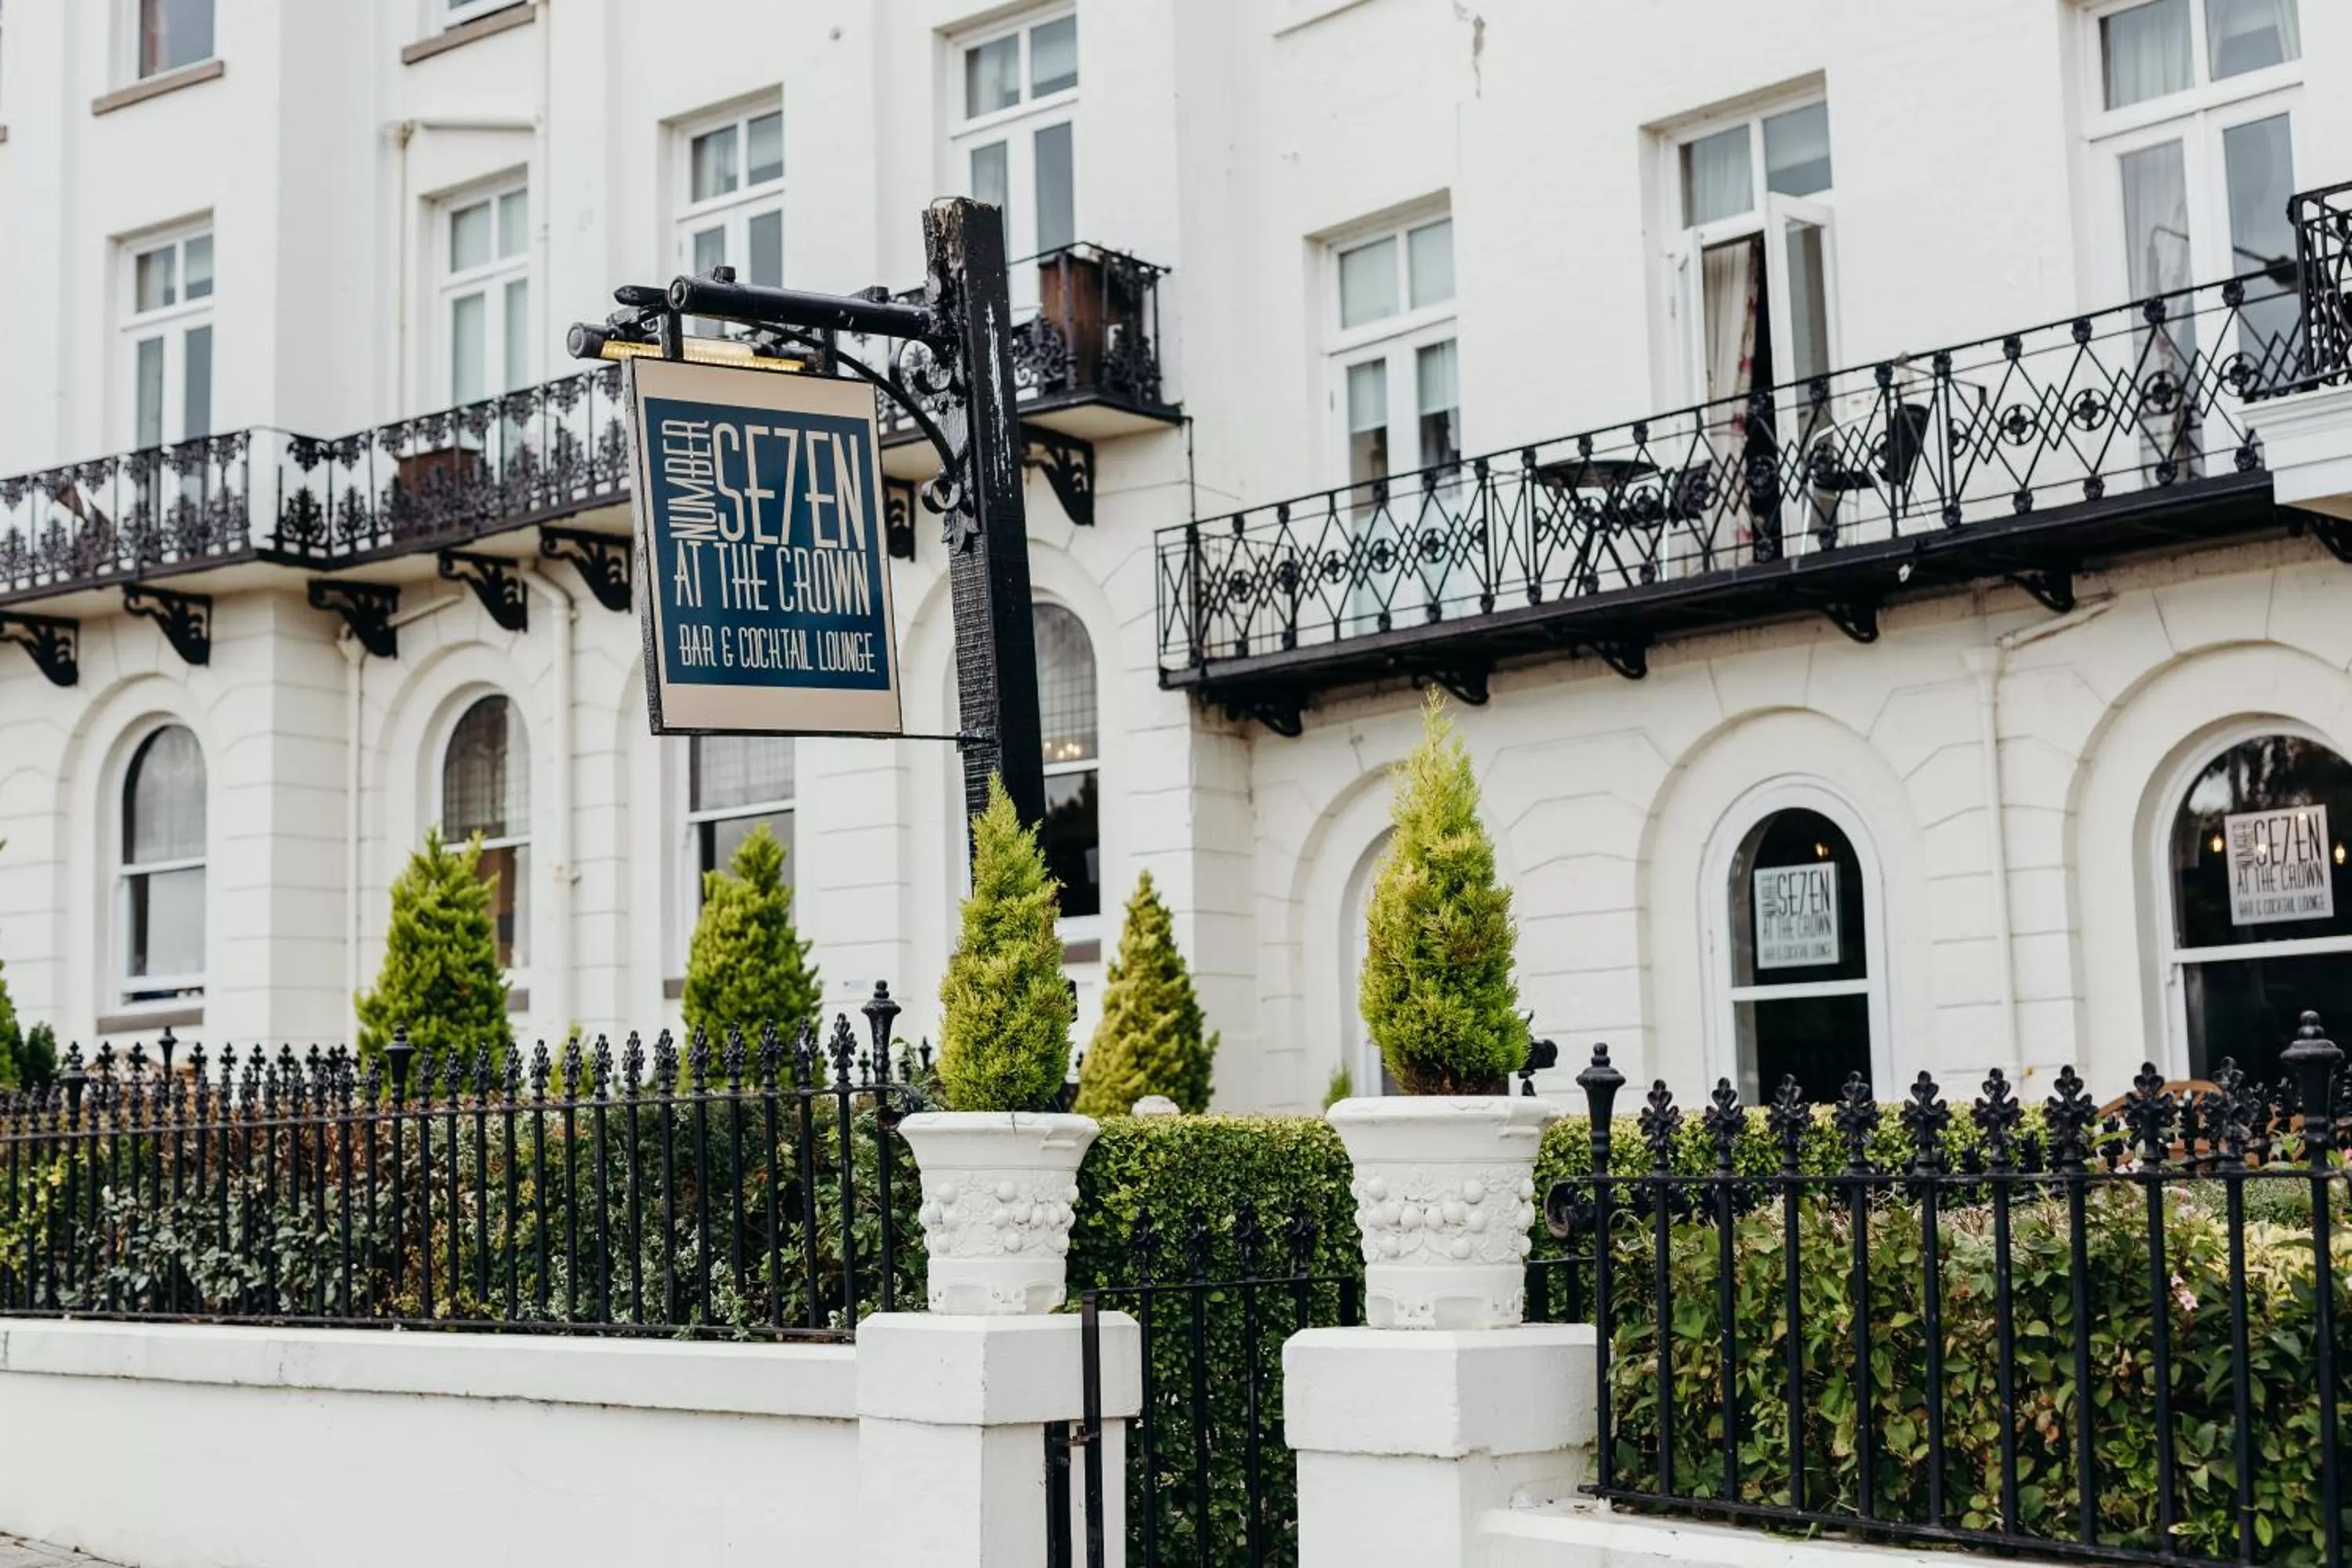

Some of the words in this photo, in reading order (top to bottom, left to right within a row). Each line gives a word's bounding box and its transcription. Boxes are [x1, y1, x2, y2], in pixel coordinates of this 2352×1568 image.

[662, 419, 718, 540] NUMBER
[713, 422, 866, 550] SE7EN
[674, 539, 702, 608] AT
[713, 542, 769, 611] THE
[775, 546, 871, 616] CROWN
[679, 624, 717, 667] BAR
[720, 626, 734, 666] &
[739, 626, 813, 671] COCKTAIL
[816, 630, 876, 673] LOUNGE
[2255, 865, 2276, 893] THE
